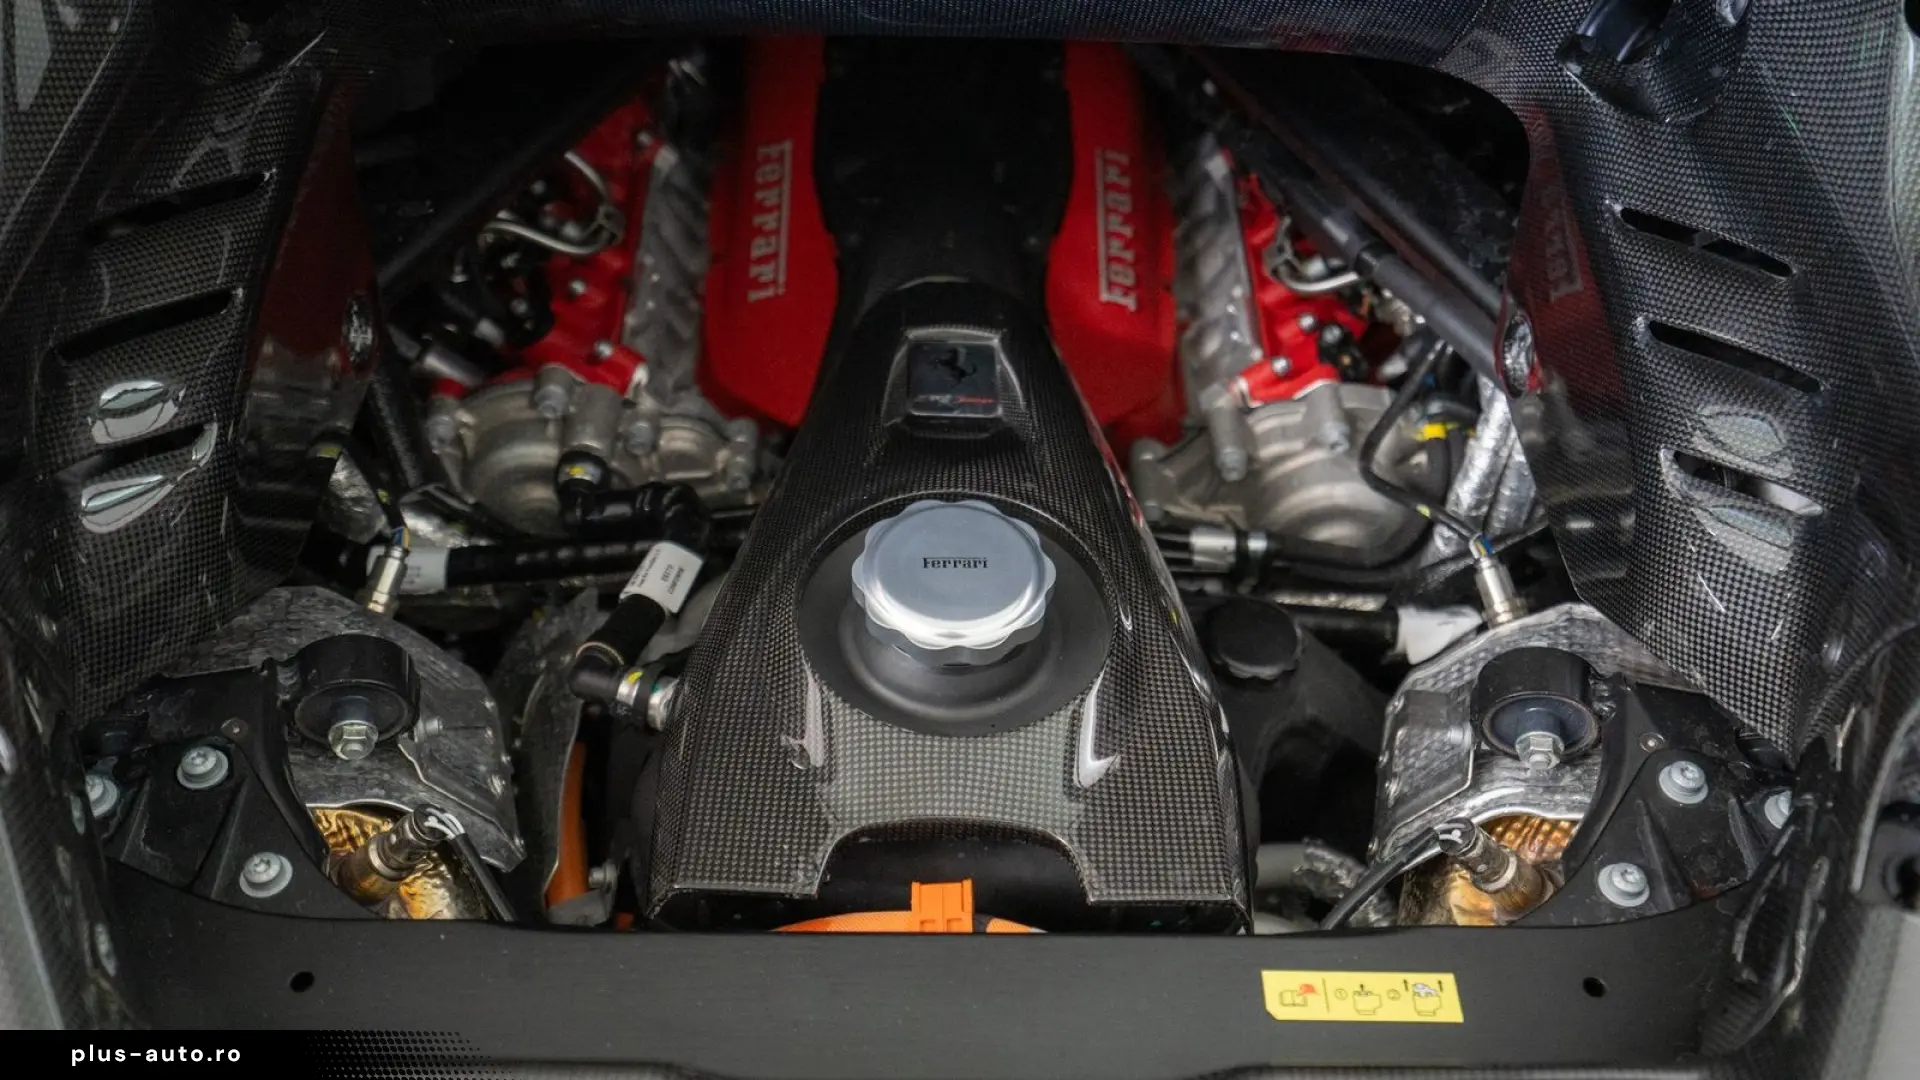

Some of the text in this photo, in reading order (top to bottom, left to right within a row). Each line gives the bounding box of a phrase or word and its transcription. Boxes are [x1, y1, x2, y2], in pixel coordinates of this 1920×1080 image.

[748, 140, 793, 303] Ferrari
[1096, 149, 1138, 312] Ferrari
[922, 556, 988, 569] Ferrari
